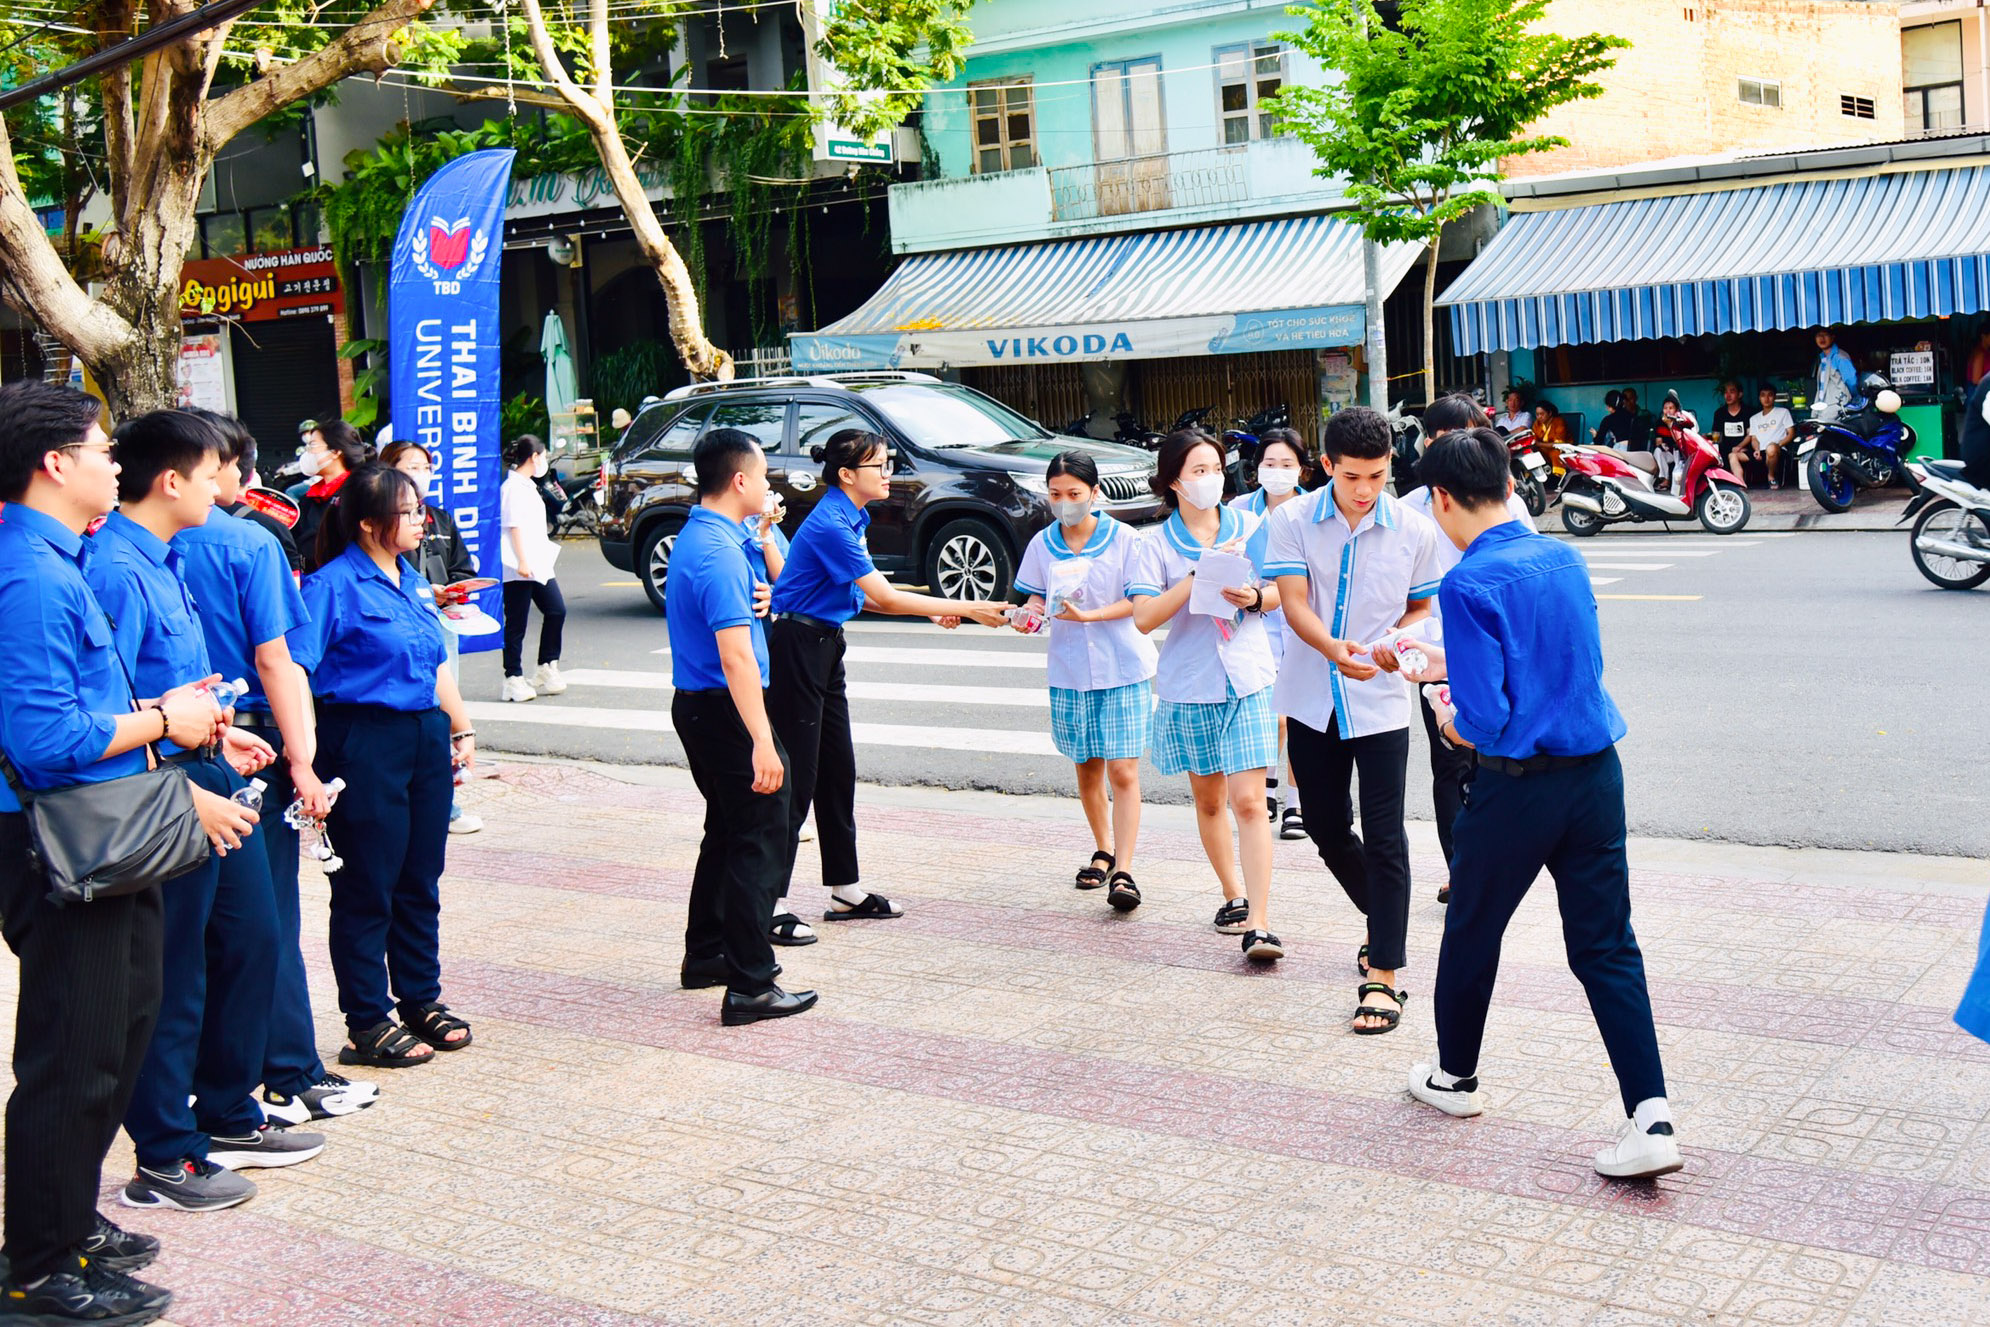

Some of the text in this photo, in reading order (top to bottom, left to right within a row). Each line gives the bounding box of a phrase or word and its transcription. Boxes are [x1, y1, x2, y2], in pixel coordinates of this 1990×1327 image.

[244, 246, 333, 270] NƯỚNG HÀN QUỐC
[185, 272, 275, 312] Gogigui
[433, 281, 460, 295] TBD
[1287, 318, 1306, 328] CHO
[451, 319, 477, 398] THAI
[986, 332, 1134, 358] VIKODA
[416, 320, 444, 509] UNIVERSIT
[452, 411, 478, 494] BINH
